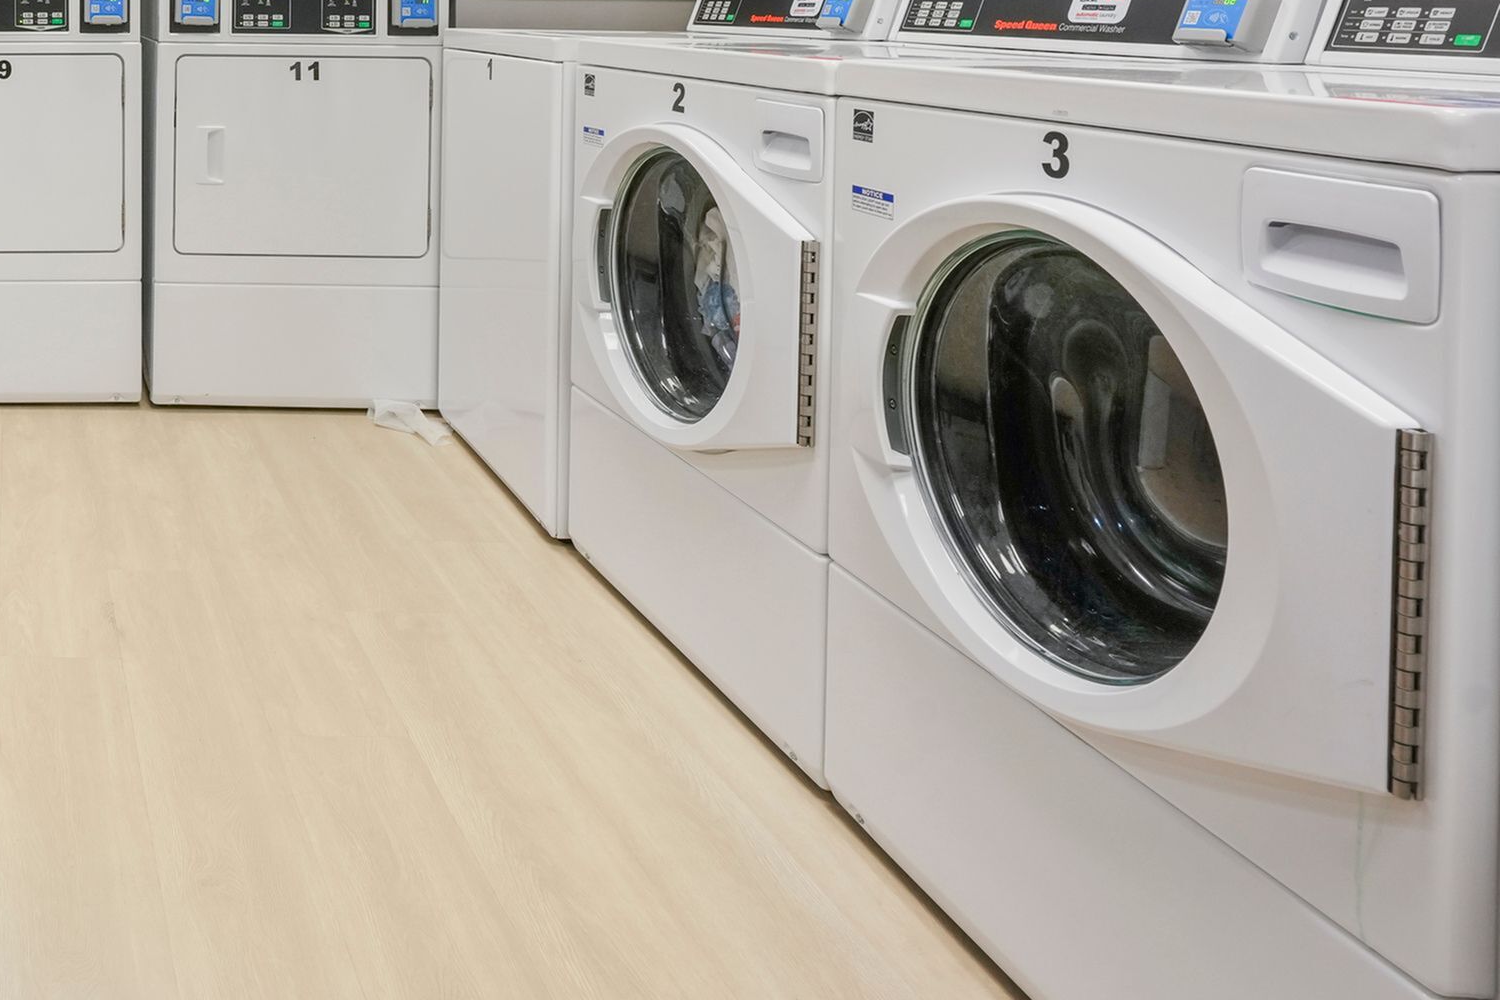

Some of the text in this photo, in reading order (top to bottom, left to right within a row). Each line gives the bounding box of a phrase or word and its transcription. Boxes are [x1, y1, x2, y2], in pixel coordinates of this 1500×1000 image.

[994, 20, 1126, 34] Speed Queen Commercial Washer
[289, 61, 320, 81] 11
[487, 58, 493, 81] 1
[671, 82, 686, 114] 2
[1041, 131, 1070, 179] 3
[861, 188, 884, 200] NOTICE
